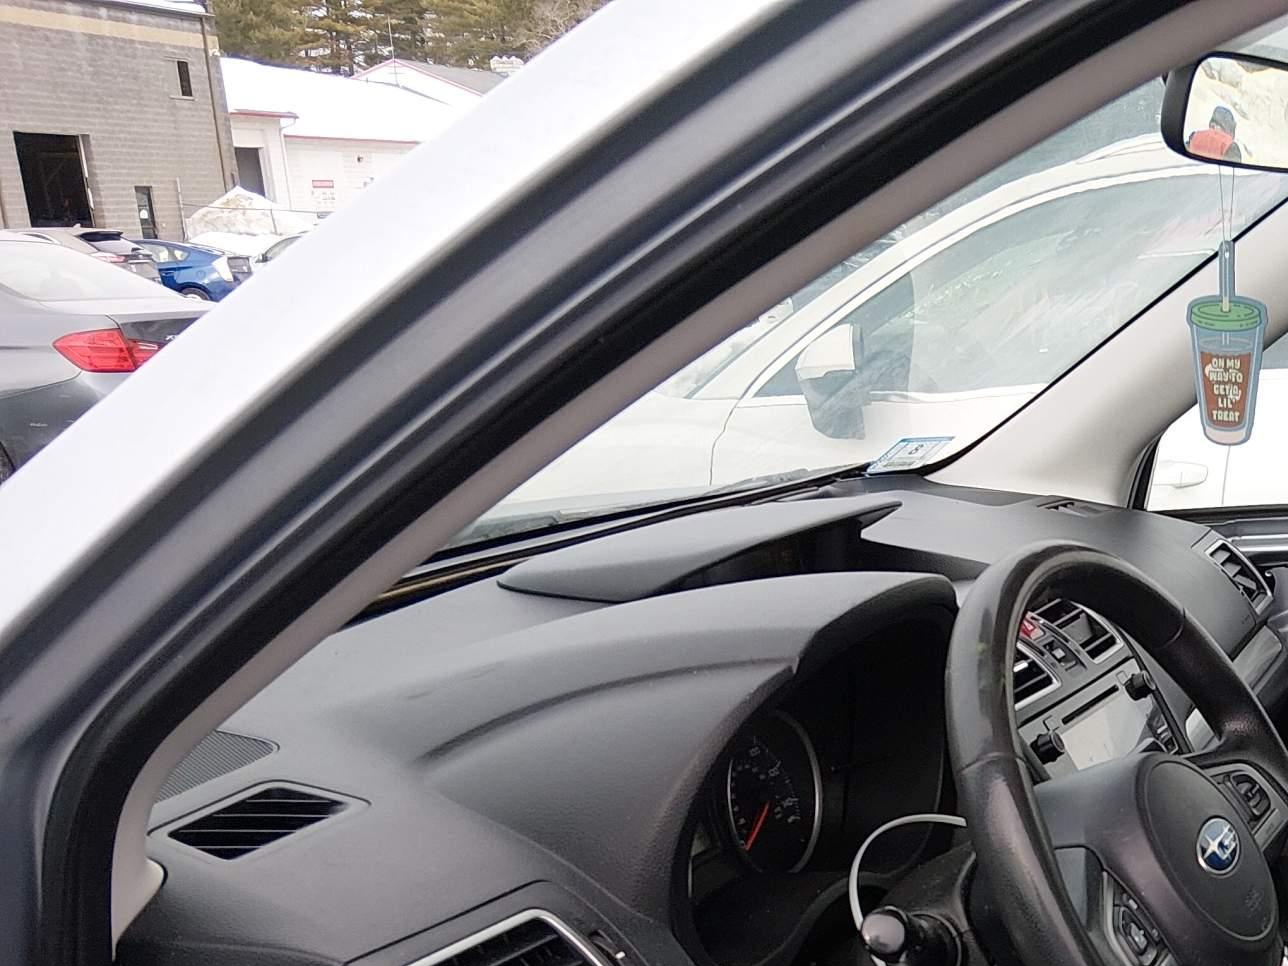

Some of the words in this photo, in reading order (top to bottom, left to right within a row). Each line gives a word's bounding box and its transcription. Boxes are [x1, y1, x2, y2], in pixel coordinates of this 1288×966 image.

[1212, 358, 1225, 369] ON
[1227, 358, 1241, 369] MY
[1209, 371, 1229, 382] WAY
[1231, 372, 1243, 383] TO
[1213, 384, 1230, 395] GET
[1212, 410, 1240, 422] TREAT
